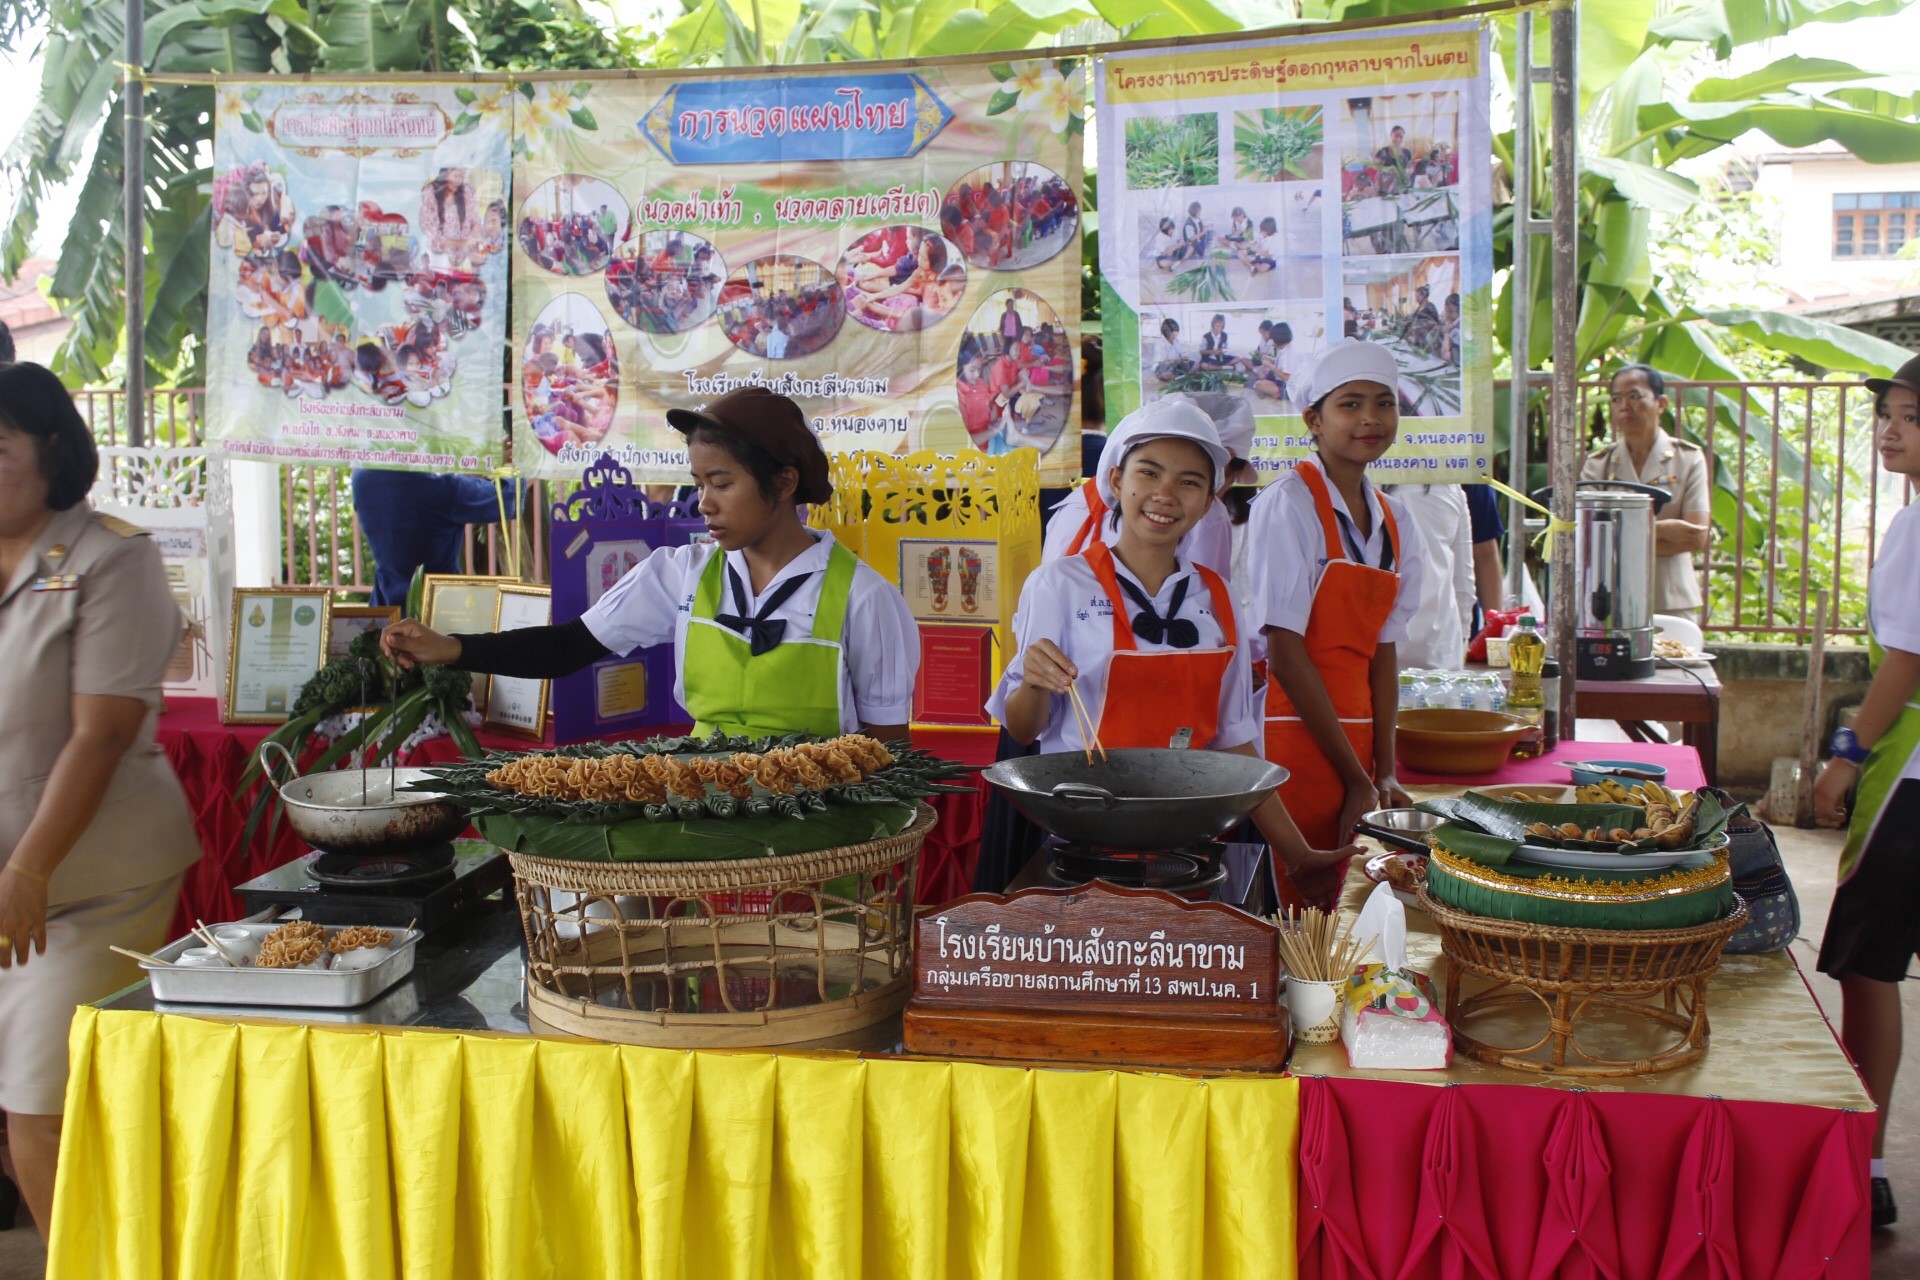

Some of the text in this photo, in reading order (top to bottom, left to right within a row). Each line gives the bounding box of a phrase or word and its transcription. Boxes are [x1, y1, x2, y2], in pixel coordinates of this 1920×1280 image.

[1115, 44, 1468, 90] โครงงานการประดิษฐ์ดอกกุหลาบจากใบเตย
[679, 87, 908, 138] การนวดแผนไทย
[1404, 433, 1485, 445] จ.หนองคาย
[1445, 458, 1468, 469] เขต
[936, 916, 1245, 971] โรงเรียนบ้านสังกะลีนาขาม
[1144, 976, 1162, 995] 13
[1168, 978, 1241, 999] สพป.นค.
[1250, 981, 1259, 1000] 1
